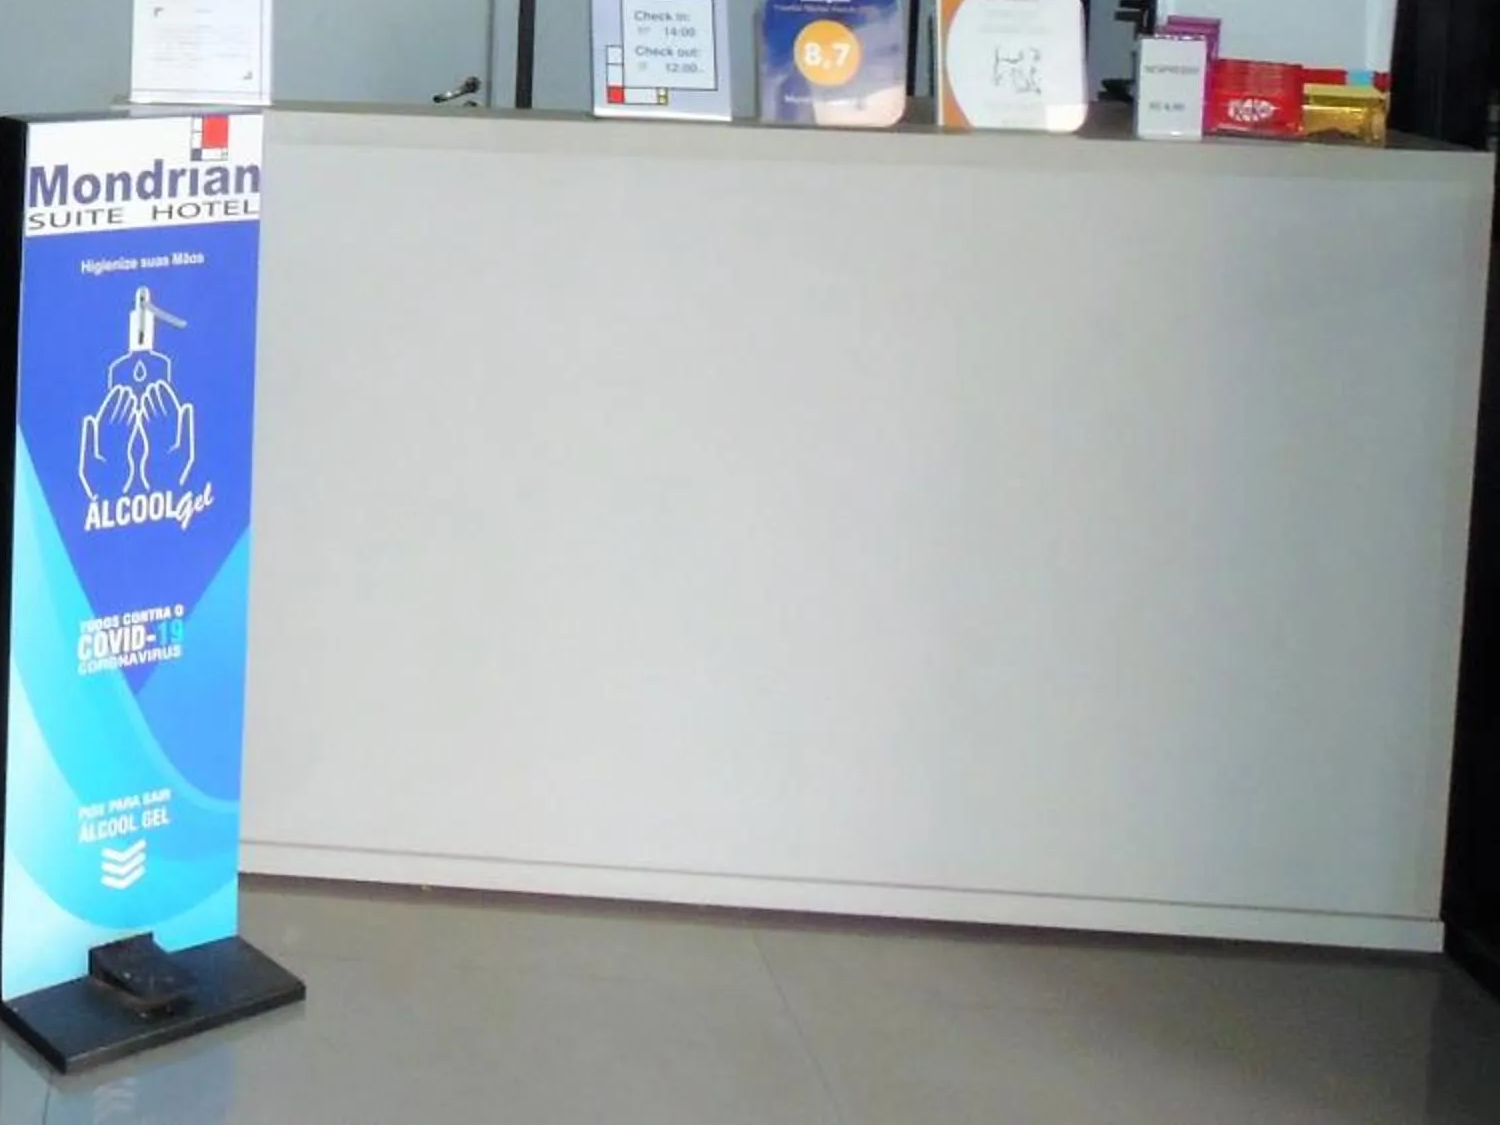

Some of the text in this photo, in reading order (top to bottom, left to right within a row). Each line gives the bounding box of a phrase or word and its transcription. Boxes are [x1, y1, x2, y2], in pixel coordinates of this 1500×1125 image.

[633, 10, 673, 22] Check
[634, 45, 673, 57] Check
[29, 158, 260, 207] Mondrian
[28, 200, 260, 230] SUITE HOTEL
[81, 257, 138, 275] Higienize
[122, 606, 172, 625] CONTRA
[174, 603, 184, 618] O
[77, 618, 184, 661] COVID-19
[141, 805, 171, 829] GEL
